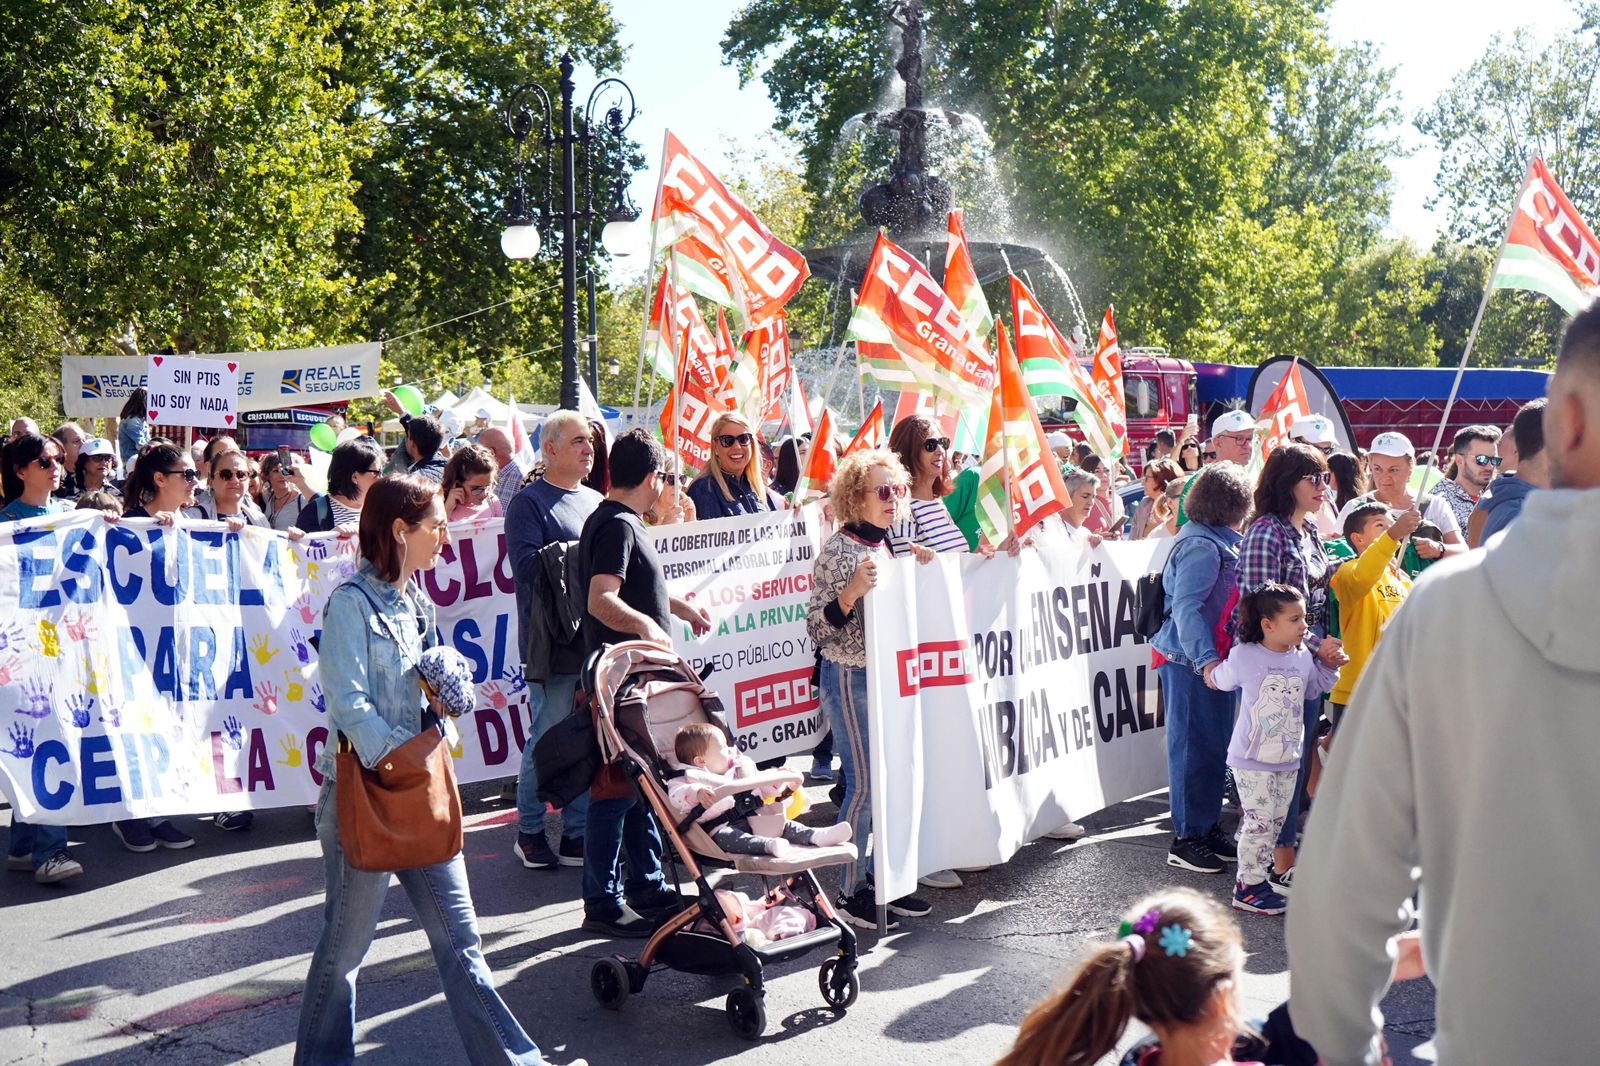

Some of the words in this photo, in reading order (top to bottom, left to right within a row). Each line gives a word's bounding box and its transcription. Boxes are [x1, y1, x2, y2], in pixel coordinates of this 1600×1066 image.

[101, 374, 148, 387] REALE
[174, 370, 191, 384] SIN
[197, 371, 220, 386] PTIS
[305, 365, 361, 381] REALE
[305, 380, 361, 393] SEGUROS
[151, 394, 166, 408] NO
[170, 395, 192, 409] SOY
[200, 397, 229, 412] NADA
[247, 409, 289, 421] CRISTALERIA
[672, 530, 735, 553] COBERTURA
[738, 528, 751, 544] DE
[754, 525, 774, 542] LAS
[12, 527, 291, 610] ESCUELA
[663, 556, 720, 580] PERSONAL
[722, 551, 771, 572] LABORAL
[773, 550, 783, 565] DE
[796, 545, 814, 562] JU
[709, 585, 746, 607] LOS
[718, 617, 730, 636] A
[735, 612, 757, 633] LA
[974, 630, 1013, 680] POR
[1031, 562, 1149, 667] ENSEÑA
[116, 625, 254, 702] PARA
[738, 640, 794, 668] PÚBLICO
[797, 637, 807, 654] Y
[741, 676, 810, 718] CCOO
[1057, 711, 1069, 755] Y
[1071, 705, 1093, 751] DE
[32, 733, 170, 810] CEIP
[211, 728, 275, 794] LA
